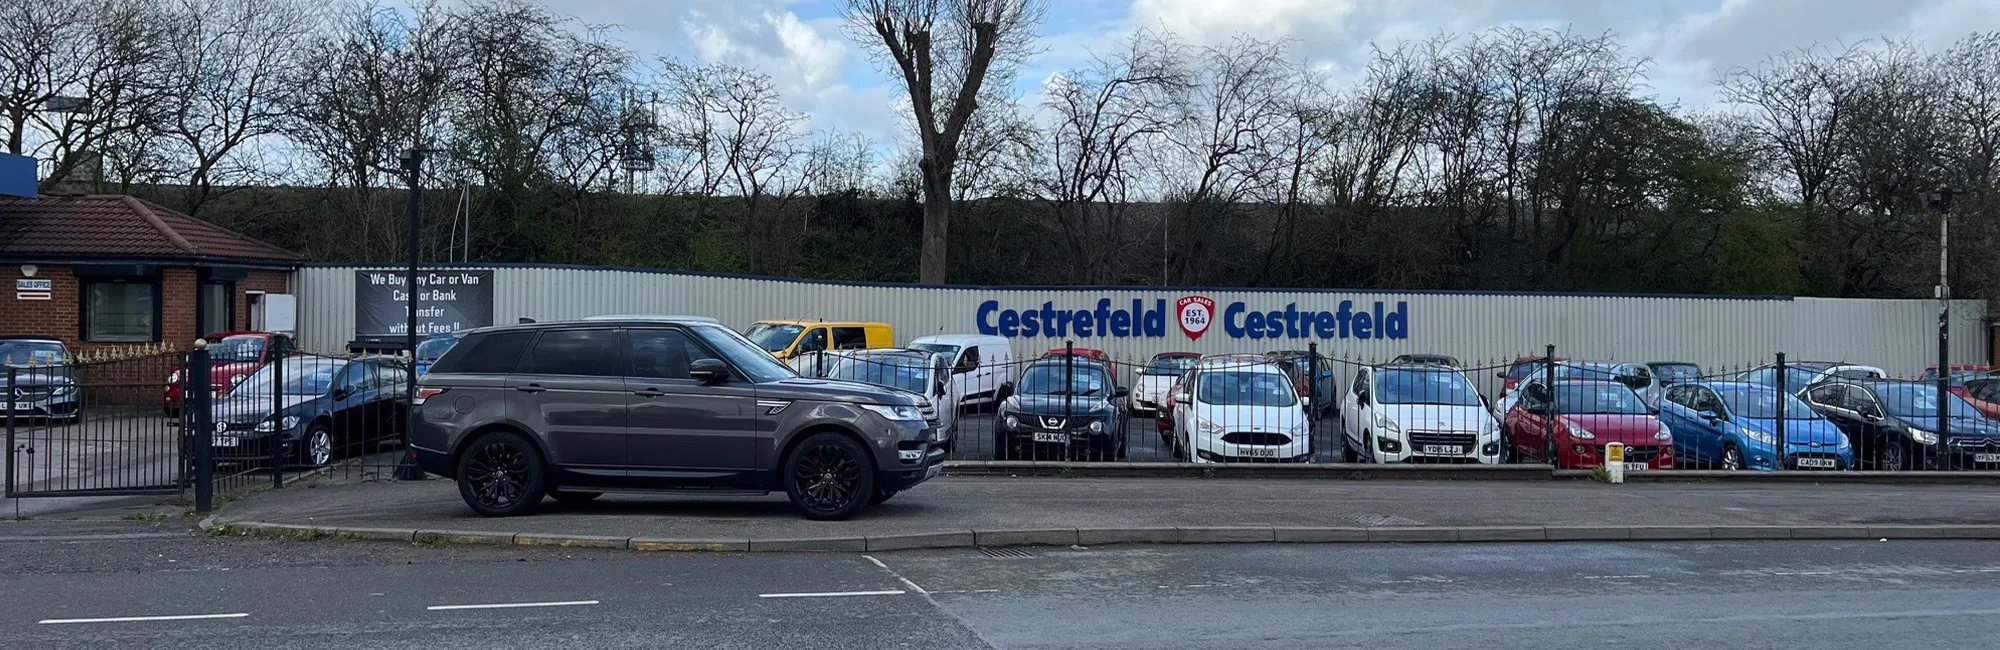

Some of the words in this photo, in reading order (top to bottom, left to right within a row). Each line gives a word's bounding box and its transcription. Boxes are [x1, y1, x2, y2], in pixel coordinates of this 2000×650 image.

[17, 280, 33, 288] SALES
[33, 280, 50, 288] OFFICE
[370, 273, 386, 285] We
[388, 273, 407, 287] Buy
[429, 273, 447, 285] Car
[448, 276, 459, 285] or
[461, 273, 479, 285] Van
[393, 289, 410, 301] Cas
[420, 293, 430, 301] or
[432, 289, 457, 301] Bank
[1179, 297, 1192, 306] CAR
[1193, 297, 1212, 306] SALES
[404, 305, 445, 317] Tnsfer
[976, 298, 1166, 338] Cestrefeld
[1224, 300, 1407, 339] Cestrefeld
[389, 322, 427, 334] withut
[428, 322, 451, 334] Fees
